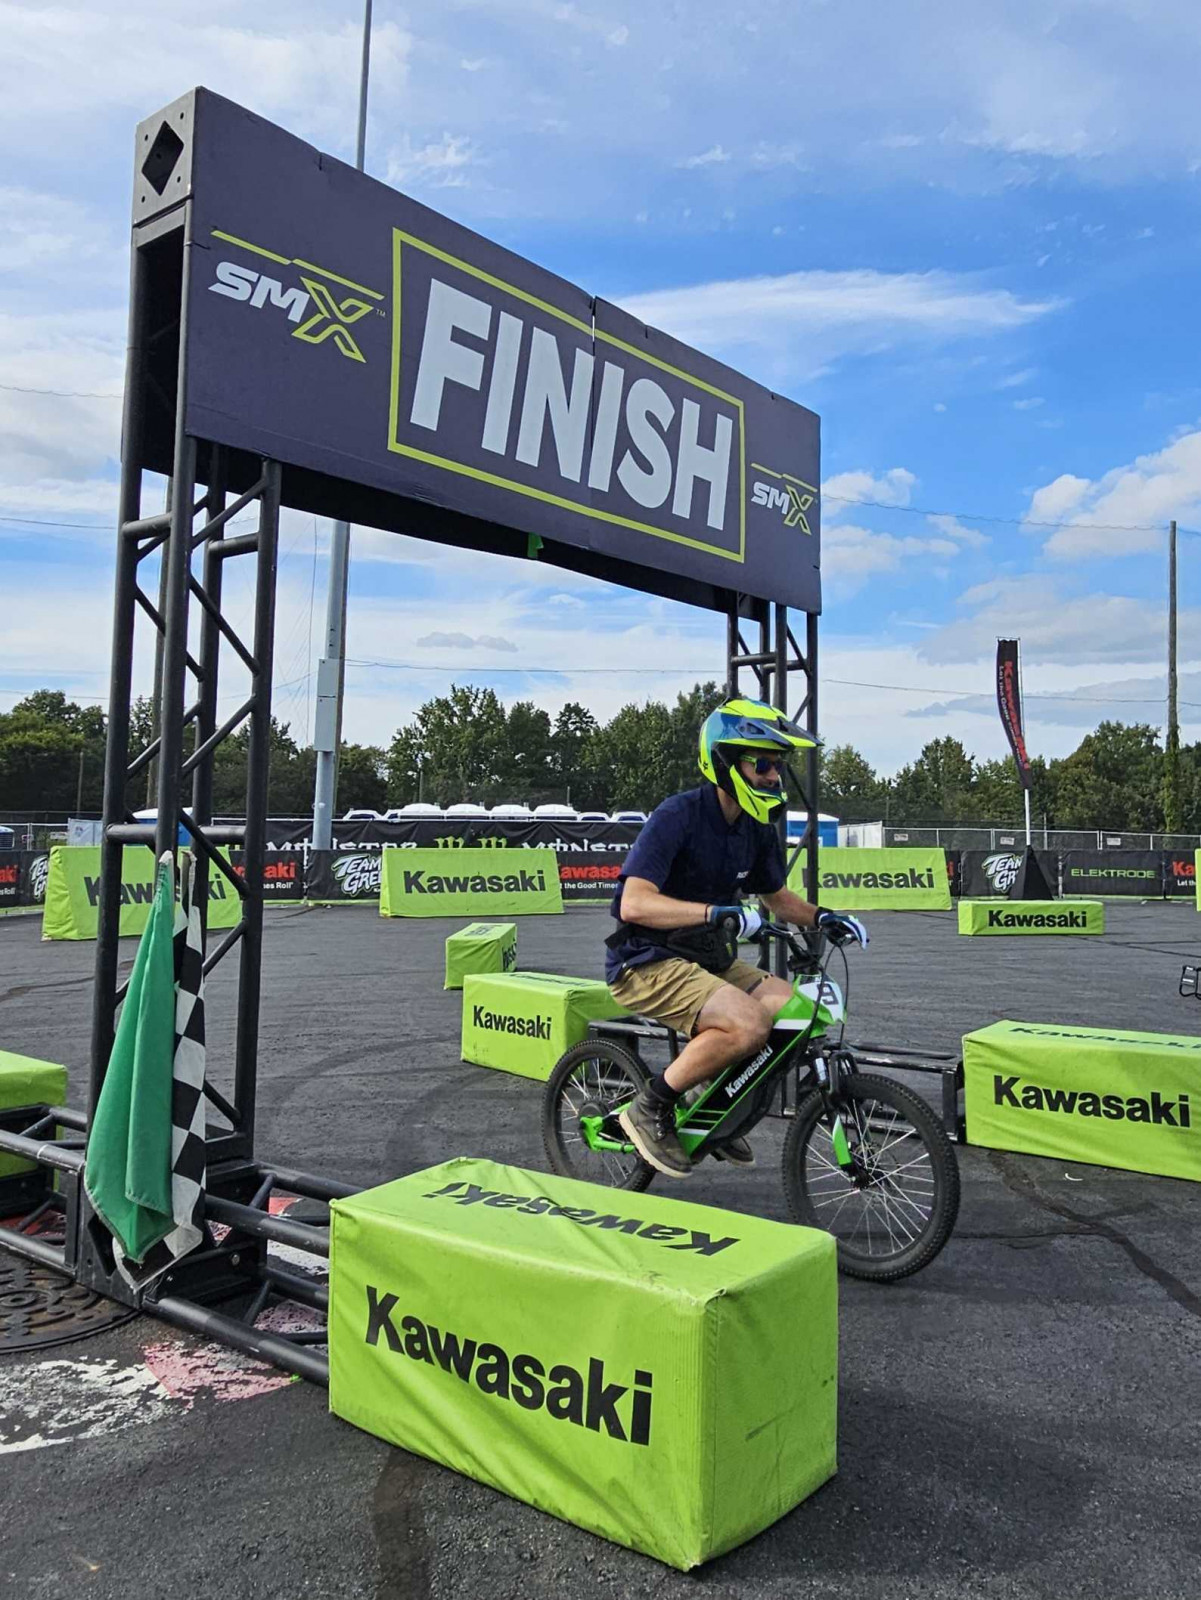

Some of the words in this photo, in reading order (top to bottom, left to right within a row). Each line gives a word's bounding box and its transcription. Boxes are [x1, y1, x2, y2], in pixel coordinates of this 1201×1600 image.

[208, 261, 375, 364] SMX
[409, 277, 733, 531] FINISH
[750, 481, 814, 535] SMX
[403, 869, 546, 894] Kawasaki
[1071, 868, 1156, 879] ELEKTRODE
[988, 910, 1087, 928] Kawasaki
[473, 1005, 552, 1040] Kawasaki
[724, 1045, 774, 1098] Kawasaki
[993, 1075, 1191, 1128] Kawasaki
[421, 1181, 741, 1257] Kawasaki
[364, 1284, 653, 1447] Kawasaki
